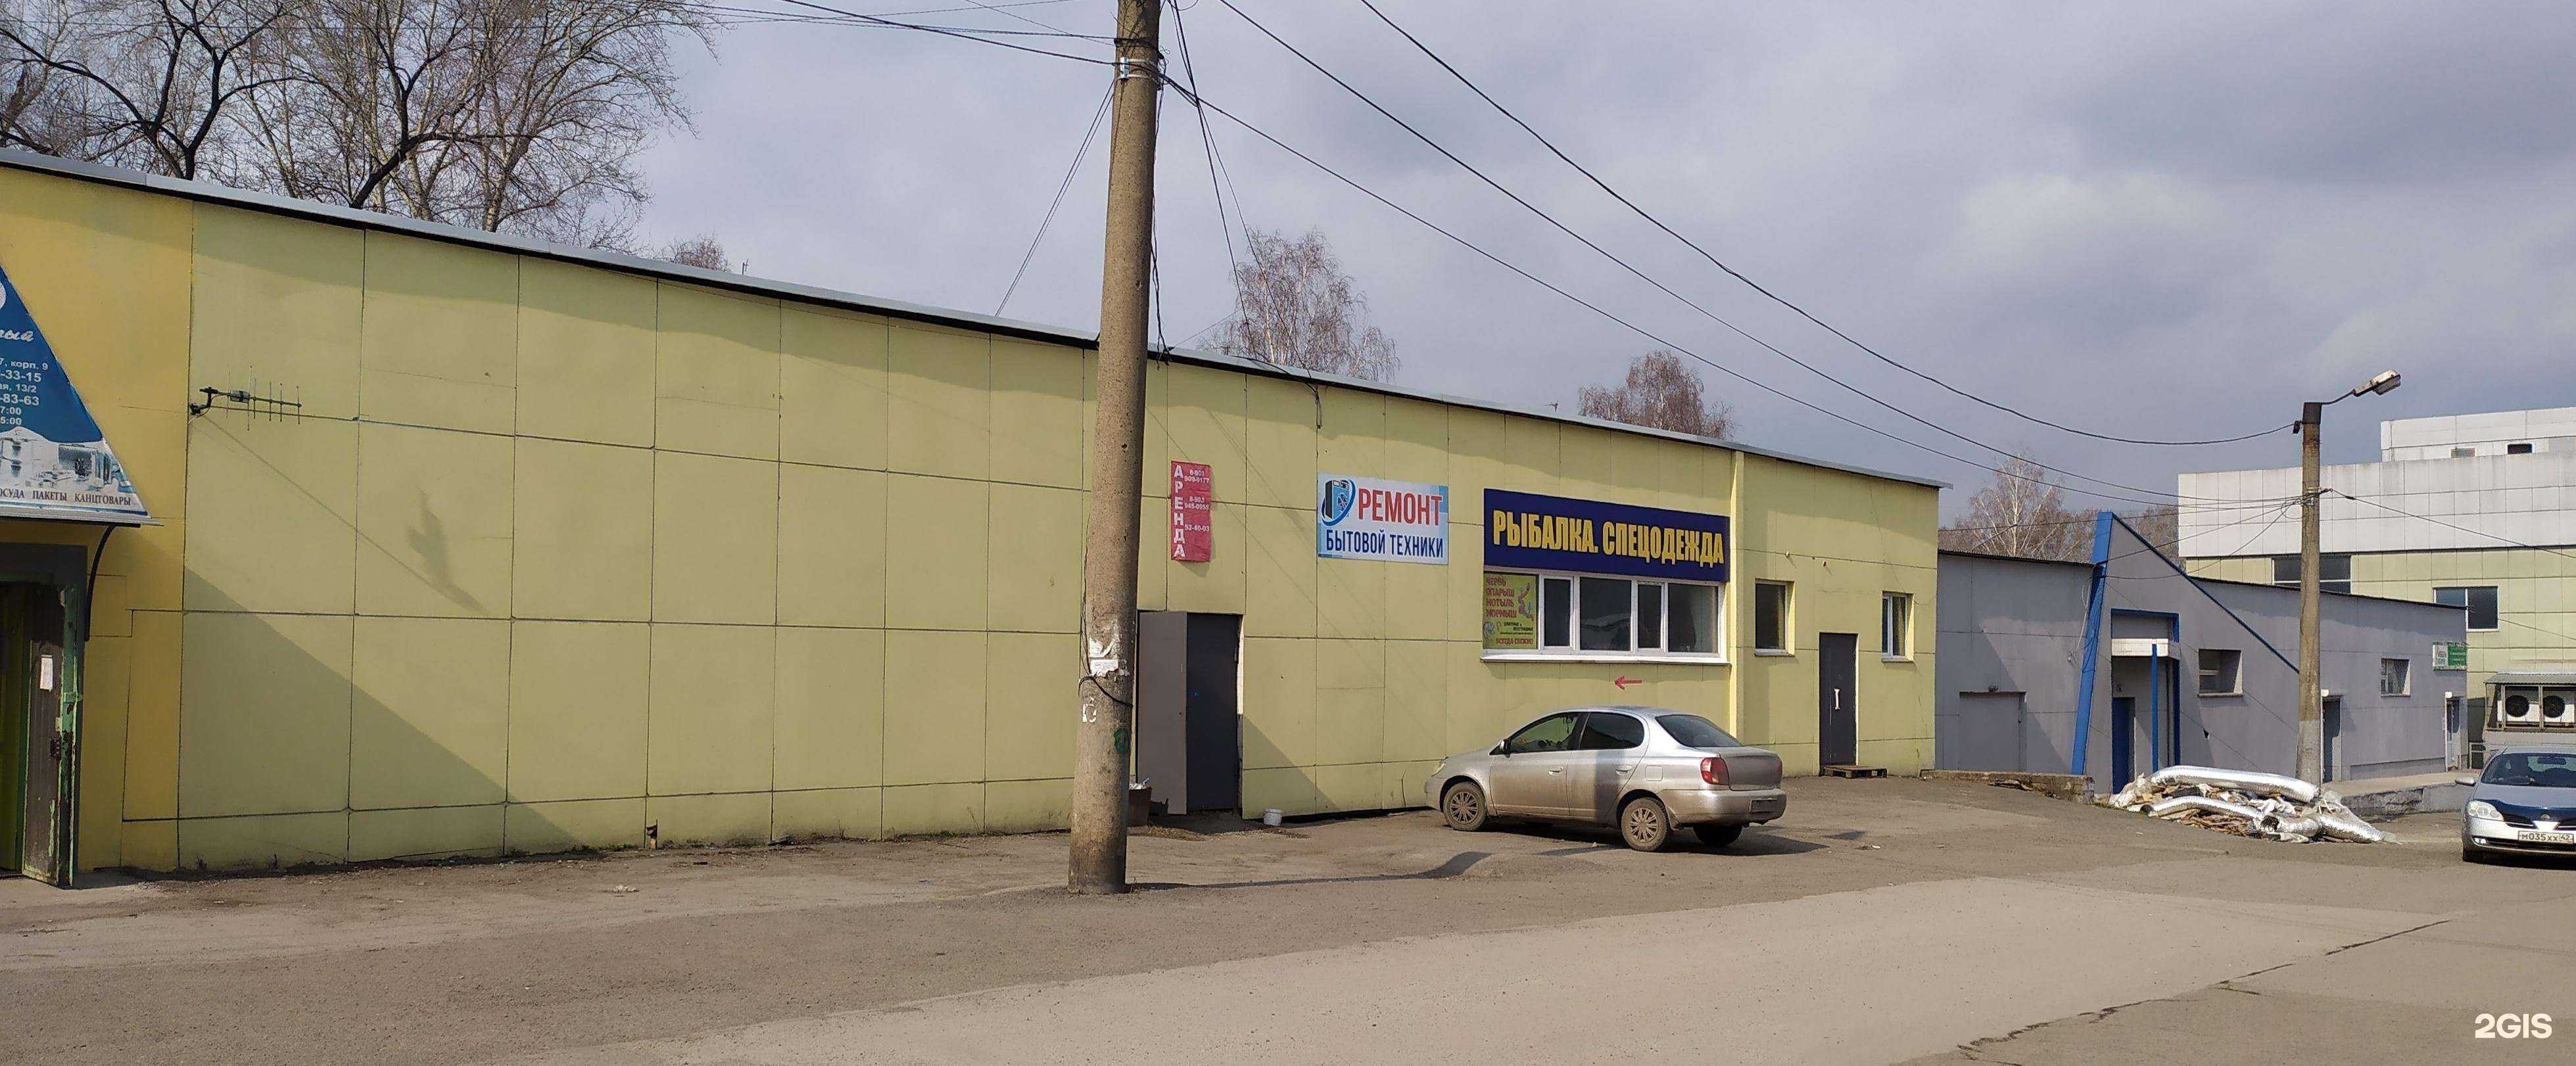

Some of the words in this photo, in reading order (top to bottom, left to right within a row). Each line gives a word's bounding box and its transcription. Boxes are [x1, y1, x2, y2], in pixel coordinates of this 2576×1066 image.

[11, 360, 39, 370] корп.
[15, 384, 37, 393] 13/2
[33, 490, 67, 501] ПАКЕТЫ
[74, 493, 131, 506] КАНЦТОВАРЫ
[1174, 465, 1185, 557] АРЕНДА
[1358, 488, 1443, 526] РЕМОНТ
[1326, 528, 1385, 555] БЫТОВОЙ
[1389, 534, 1443, 559] ТЕХНИКИ
[1492, 509, 1598, 553] РЫБАЛКА.
[1602, 521, 1725, 568] СПЕЦОДЕЖДА
[1486, 588, 1515, 597] ОПАРЫШ
[1486, 598, 1514, 607] МОТЫЛЬ
[1486, 609, 1517, 618] МОРМЫШ
